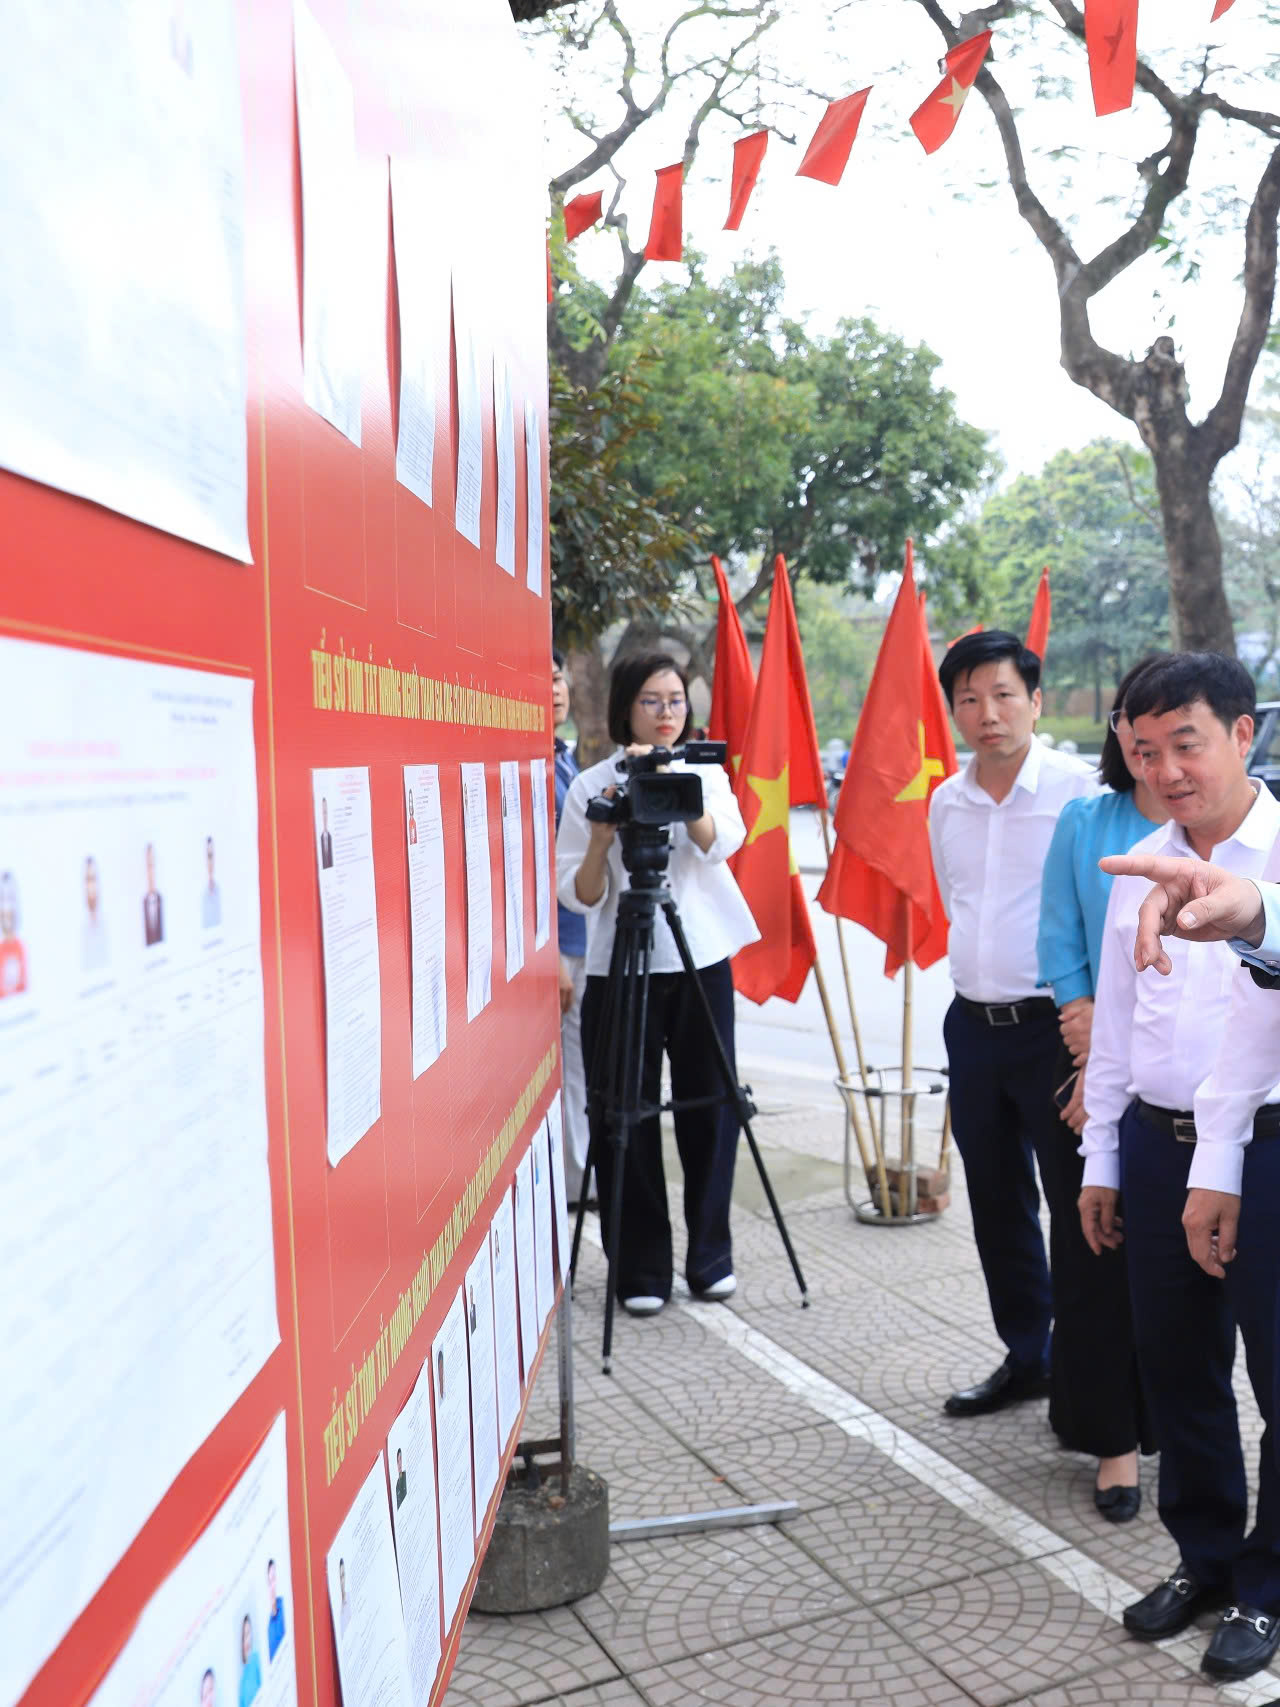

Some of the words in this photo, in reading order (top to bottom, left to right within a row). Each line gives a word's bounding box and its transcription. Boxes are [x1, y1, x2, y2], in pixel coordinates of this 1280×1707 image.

[311, 627, 332, 710] TIỂU
[334, 636, 346, 712] SỬ
[346, 647, 364, 713] TÓM
[365, 642, 378, 715] TẮT
[323, 1386, 345, 1488] TIỂU
[345, 1362, 359, 1448] SỬ
[358, 1350, 376, 1425] TÓM
[376, 1313, 390, 1393] TẮT
